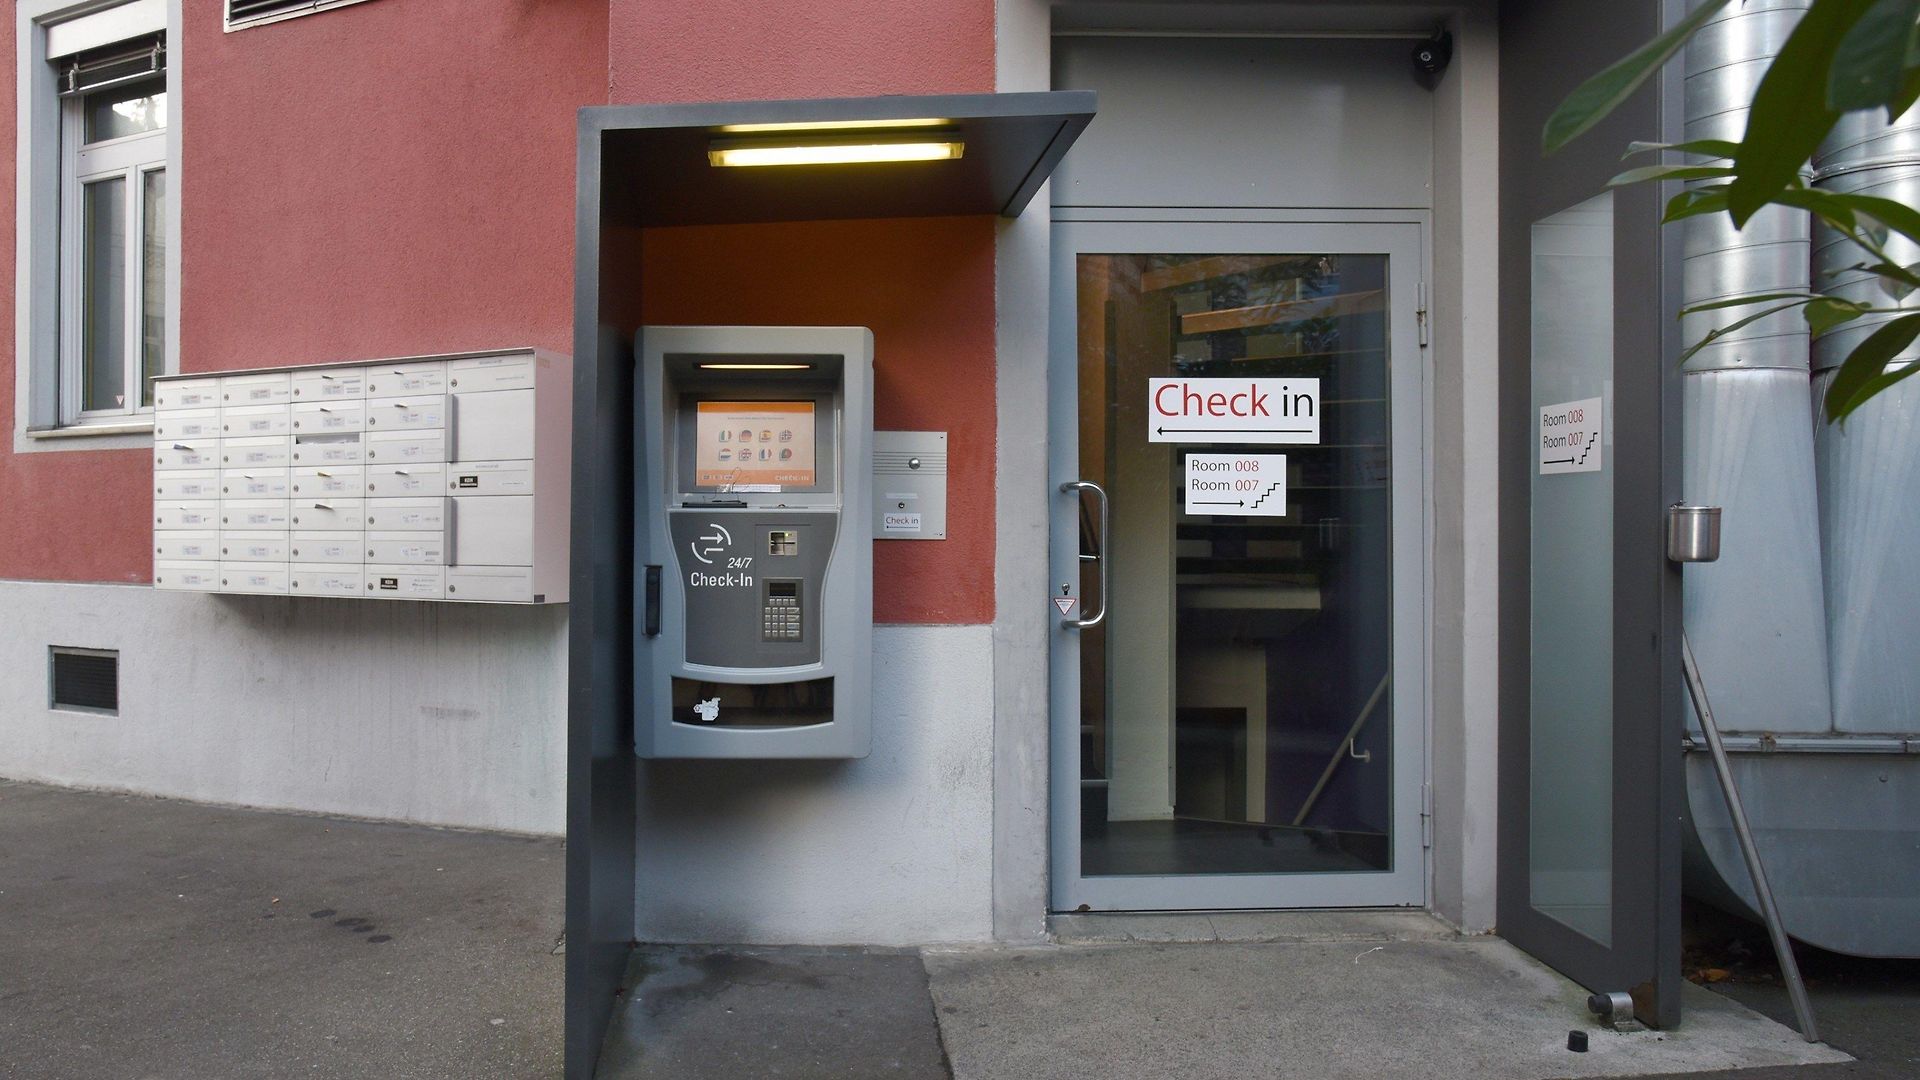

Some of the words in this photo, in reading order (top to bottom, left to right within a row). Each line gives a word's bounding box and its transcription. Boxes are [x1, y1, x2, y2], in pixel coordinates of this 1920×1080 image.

[1154, 383, 1270, 417] Check
[1282, 385, 1314, 417] in
[1543, 414, 1567, 427] Room
[1568, 409, 1584, 424] 008
[1543, 435, 1567, 448] Room
[1568, 432, 1584, 446] 007
[1191, 459, 1230, 472] Room
[1235, 460, 1259, 472] 008
[1191, 478, 1230, 491] Room
[1235, 479, 1259, 491] 007
[885, 516, 910, 525] Check
[911, 516, 919, 525] in
[727, 557, 753, 569] 24/7
[690, 572, 753, 587] Check-In
